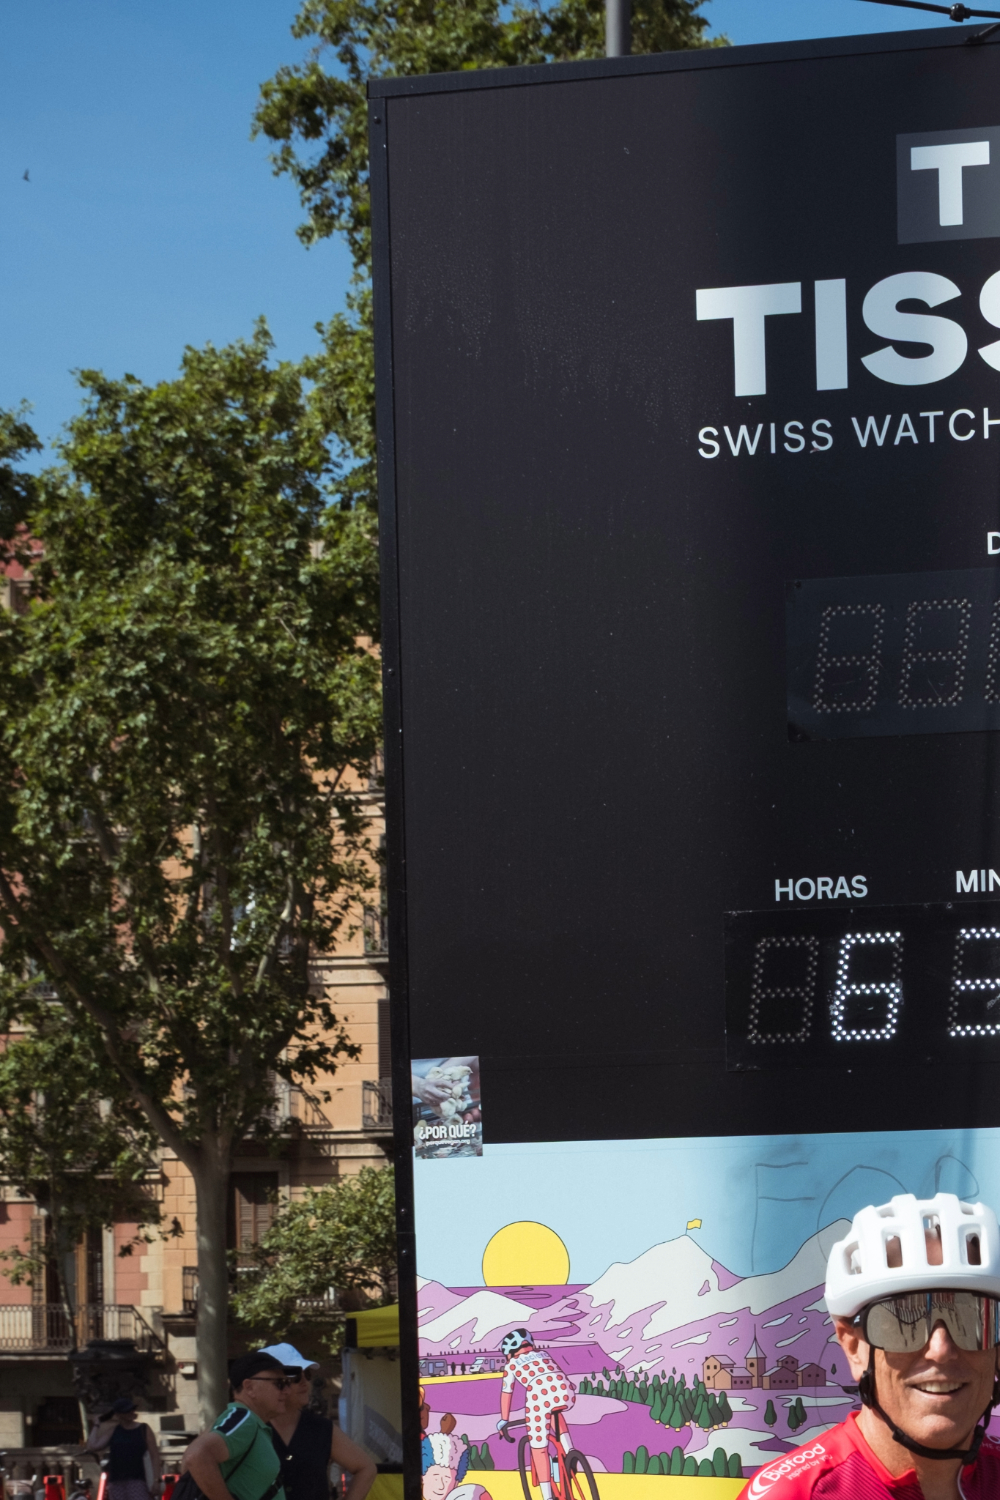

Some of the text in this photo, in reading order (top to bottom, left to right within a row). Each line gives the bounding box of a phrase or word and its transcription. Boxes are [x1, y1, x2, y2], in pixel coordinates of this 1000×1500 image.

[698, 416, 834, 459] SWISS
[773, 875, 869, 903] HORAS
[418, 1120, 477, 1140] ¿POR QUÉ?
[761, 1443, 826, 1482] Bidfood
